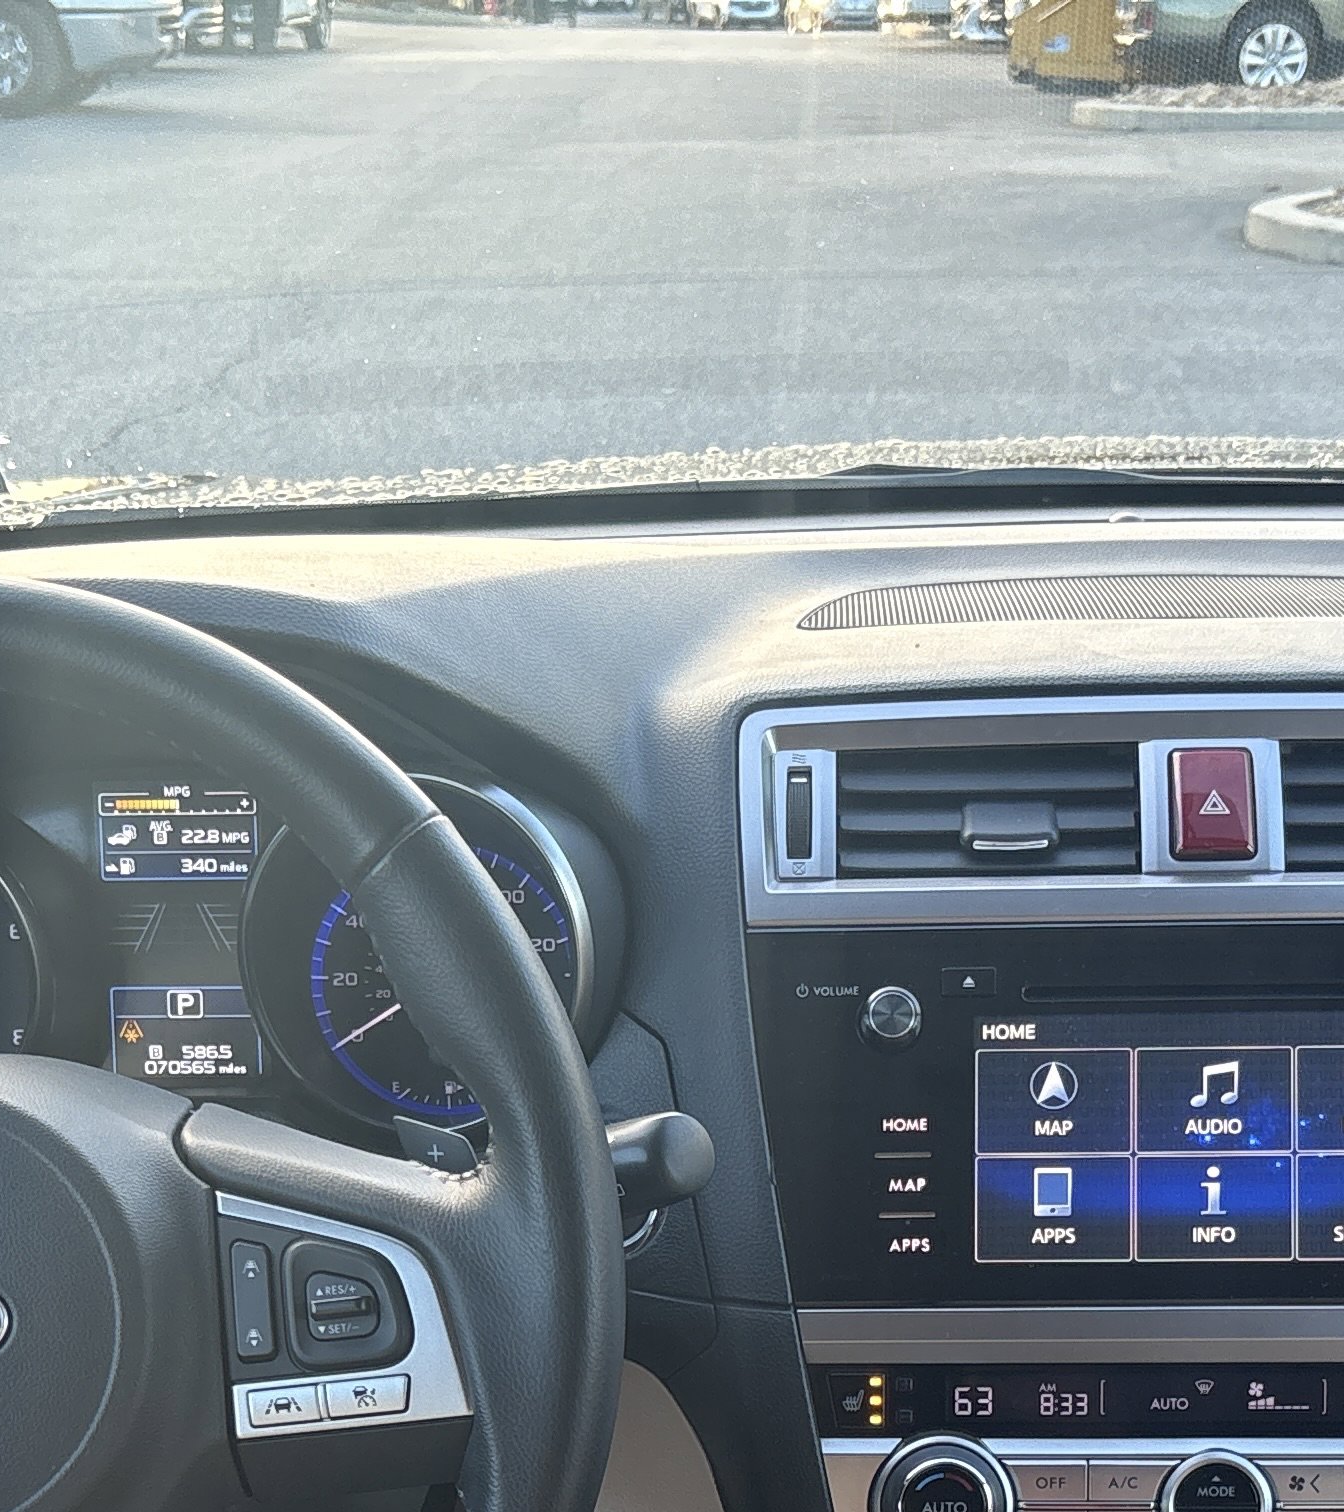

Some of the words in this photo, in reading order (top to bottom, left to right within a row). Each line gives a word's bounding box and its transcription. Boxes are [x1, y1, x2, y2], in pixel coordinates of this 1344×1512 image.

[163, 785, 191, 798] MPG
[222, 832, 250, 844] MPG
[180, 858, 218, 873] 340
[220, 860, 249, 873] miles
[502, 889, 525, 904] 00
[531, 938, 556, 952] 20
[333, 972, 358, 986] 20
[813, 985, 859, 997] VOLUME
[177, 993, 195, 1016] P
[982, 1024, 1036, 1040] HOME
[144, 1060, 216, 1075] 070565
[219, 1062, 248, 1075] miles
[392, 1082, 400, 1093] E
[882, 1118, 928, 1132] HOME
[1034, 1120, 1073, 1136] MAP
[1184, 1117, 1243, 1135] AUDIO
[888, 1177, 927, 1192] MAP
[1031, 1227, 1076, 1244] APPS
[1191, 1226, 1236, 1244] INFO
[889, 1238, 930, 1253] APPS
[1038, 1383, 1057, 1392] AM
[954, 1386, 993, 1416] 63
[1039, 1393, 1089, 1416] 8:33
[1150, 1397, 1189, 1411] AUTO
[1035, 1476, 1067, 1490] OFF
[1108, 1476, 1138, 1490] A/C
[1196, 1485, 1236, 1498] MODE
